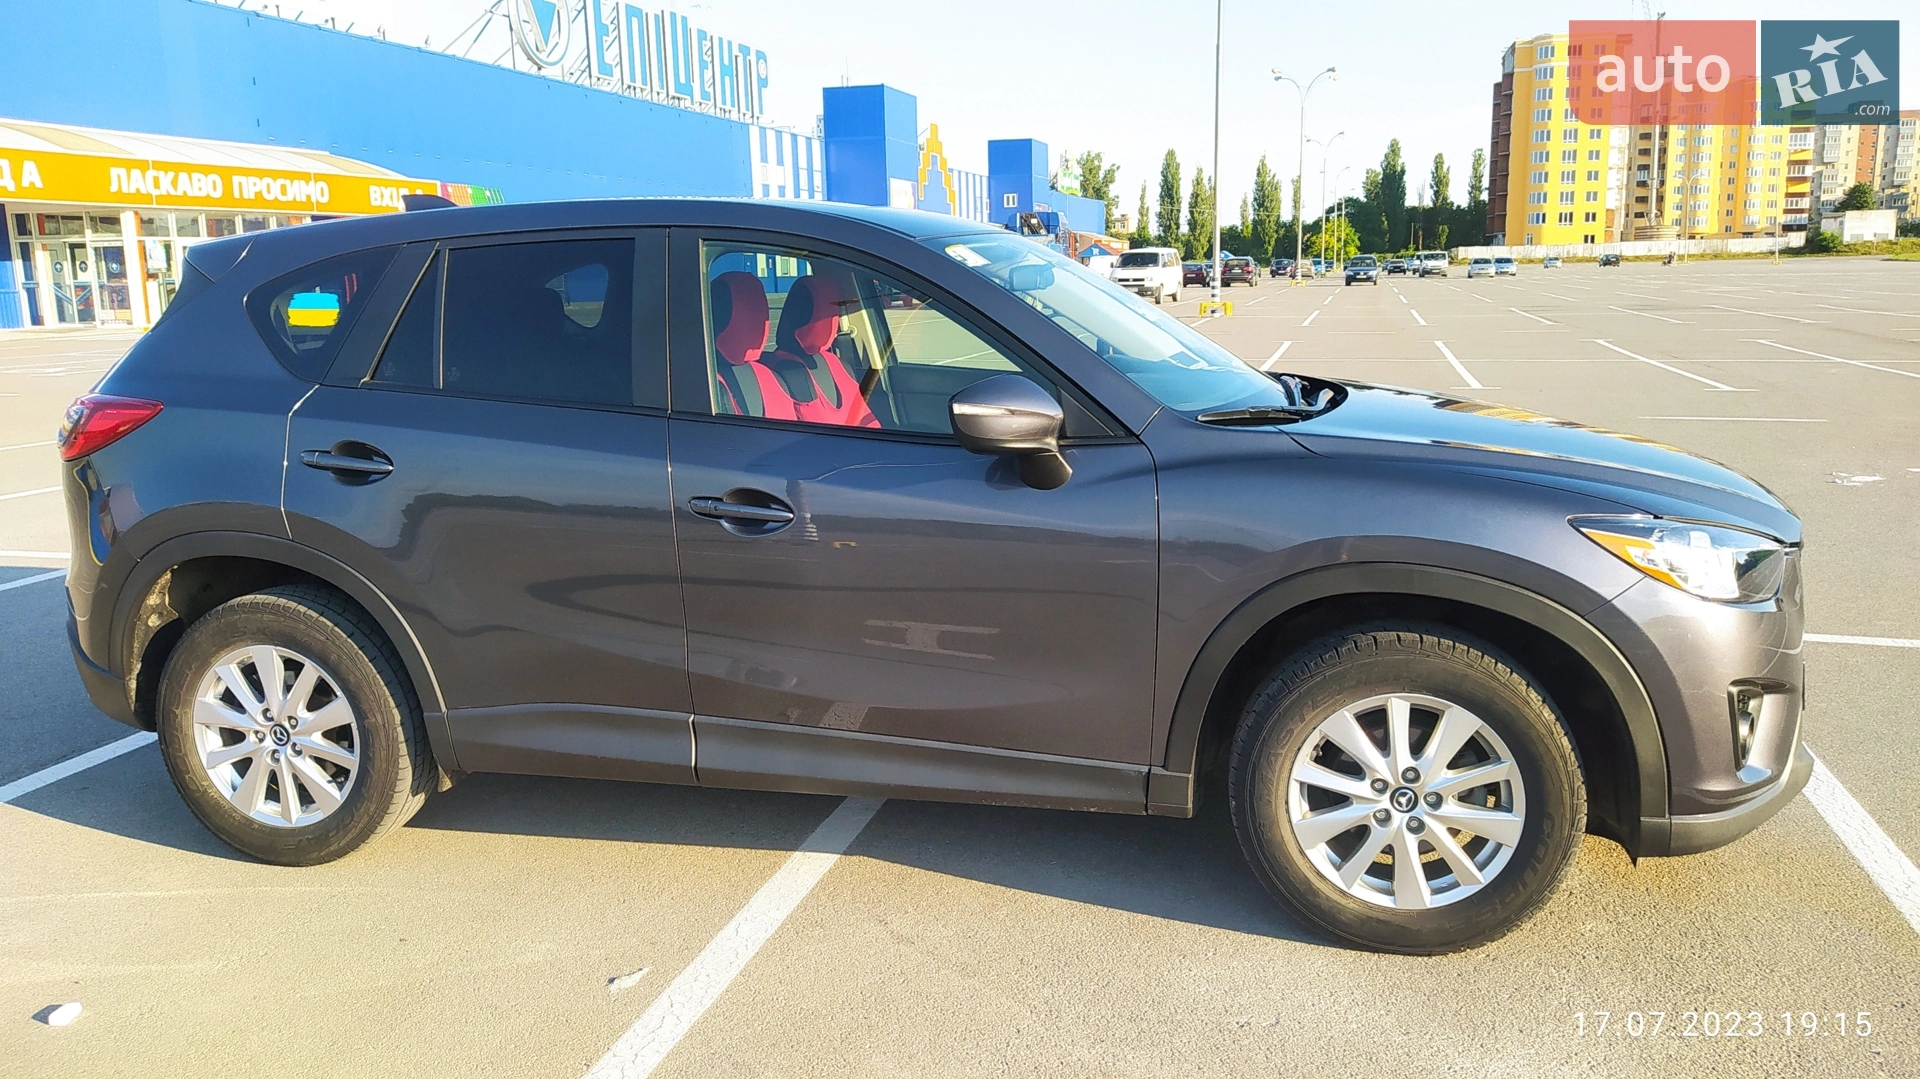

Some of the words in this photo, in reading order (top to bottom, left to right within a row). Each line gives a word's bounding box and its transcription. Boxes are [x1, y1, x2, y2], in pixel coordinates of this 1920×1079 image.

[590, 0, 769, 116] ЕПІЦЕНТР
[109, 167, 223, 199] ЛАСКАВО
[232, 175, 330, 203] ПРОСИМО
